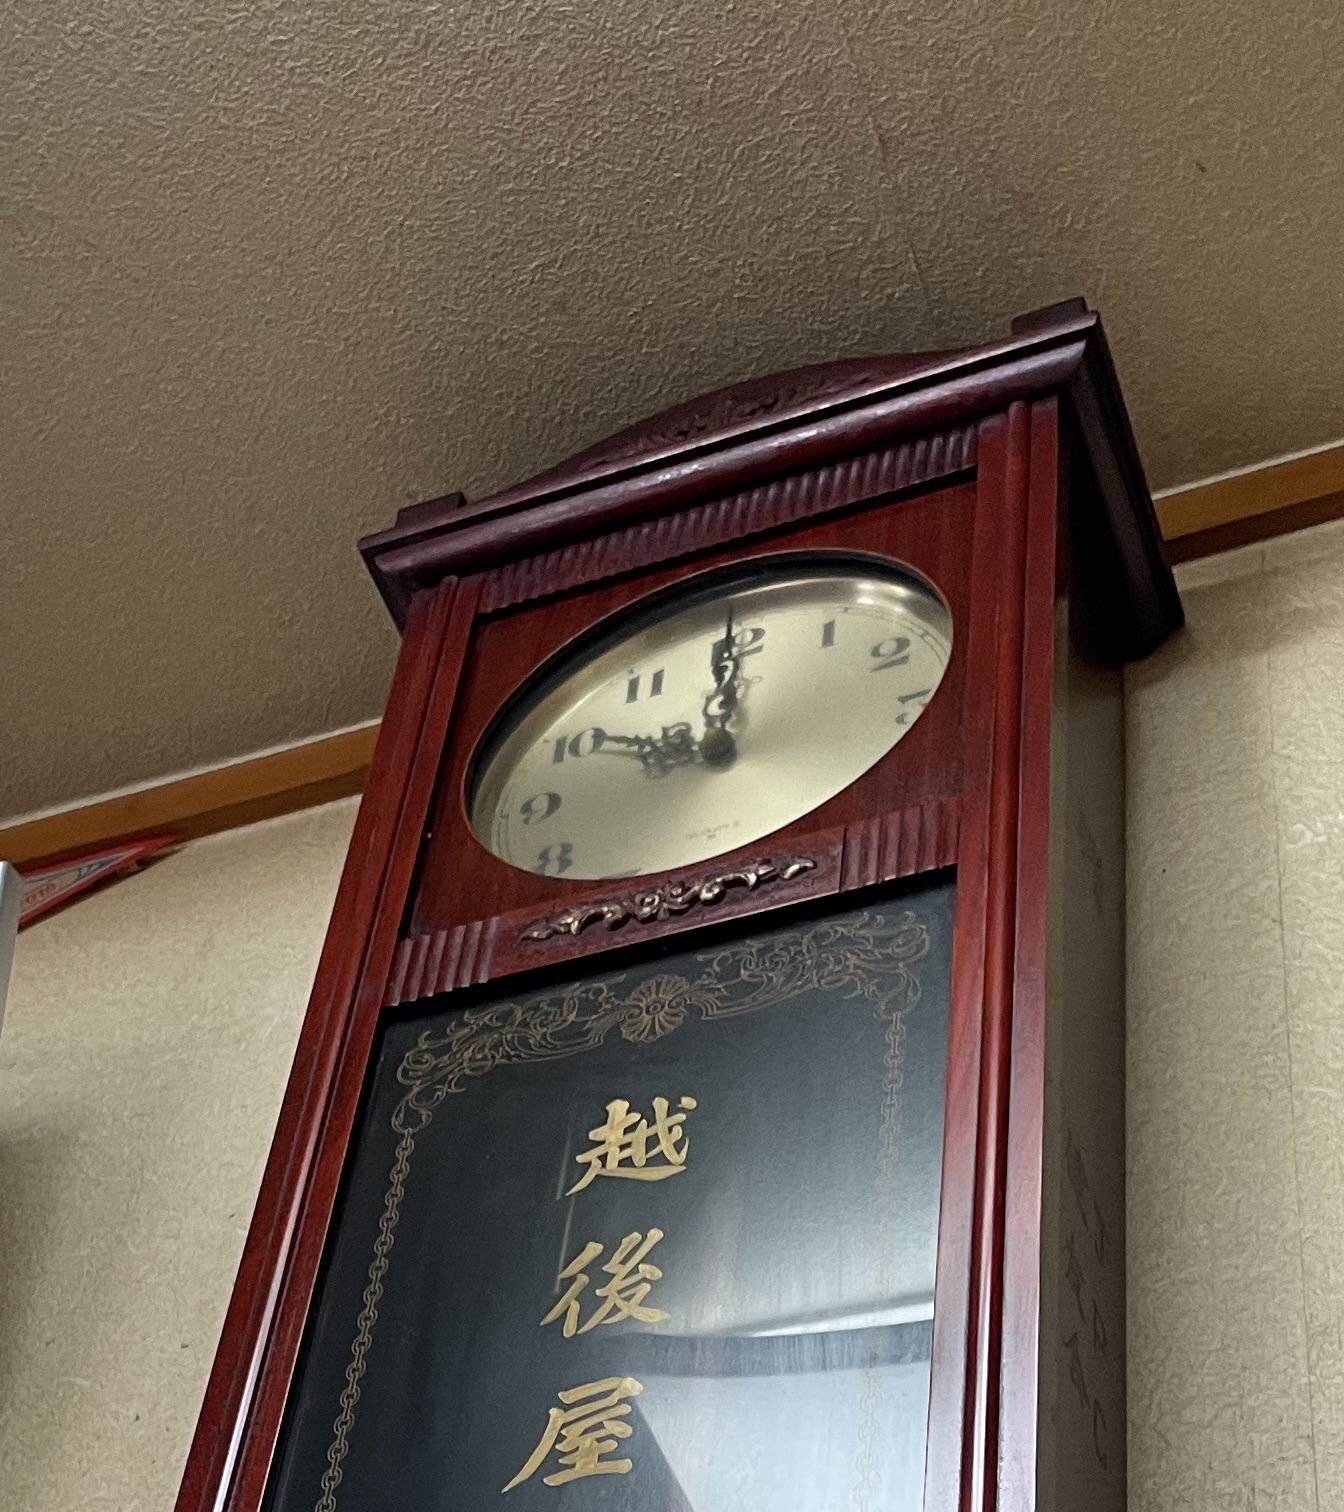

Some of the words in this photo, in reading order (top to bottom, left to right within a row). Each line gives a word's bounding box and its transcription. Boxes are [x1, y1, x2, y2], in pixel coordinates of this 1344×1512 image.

[821, 619, 836, 649] 1
[869, 636, 912, 673] 2
[626, 668, 665, 704] 11
[552, 727, 607, 765] 10
[520, 792, 562, 825] 9
[501, 1096, 697, 1494] 越後屋
